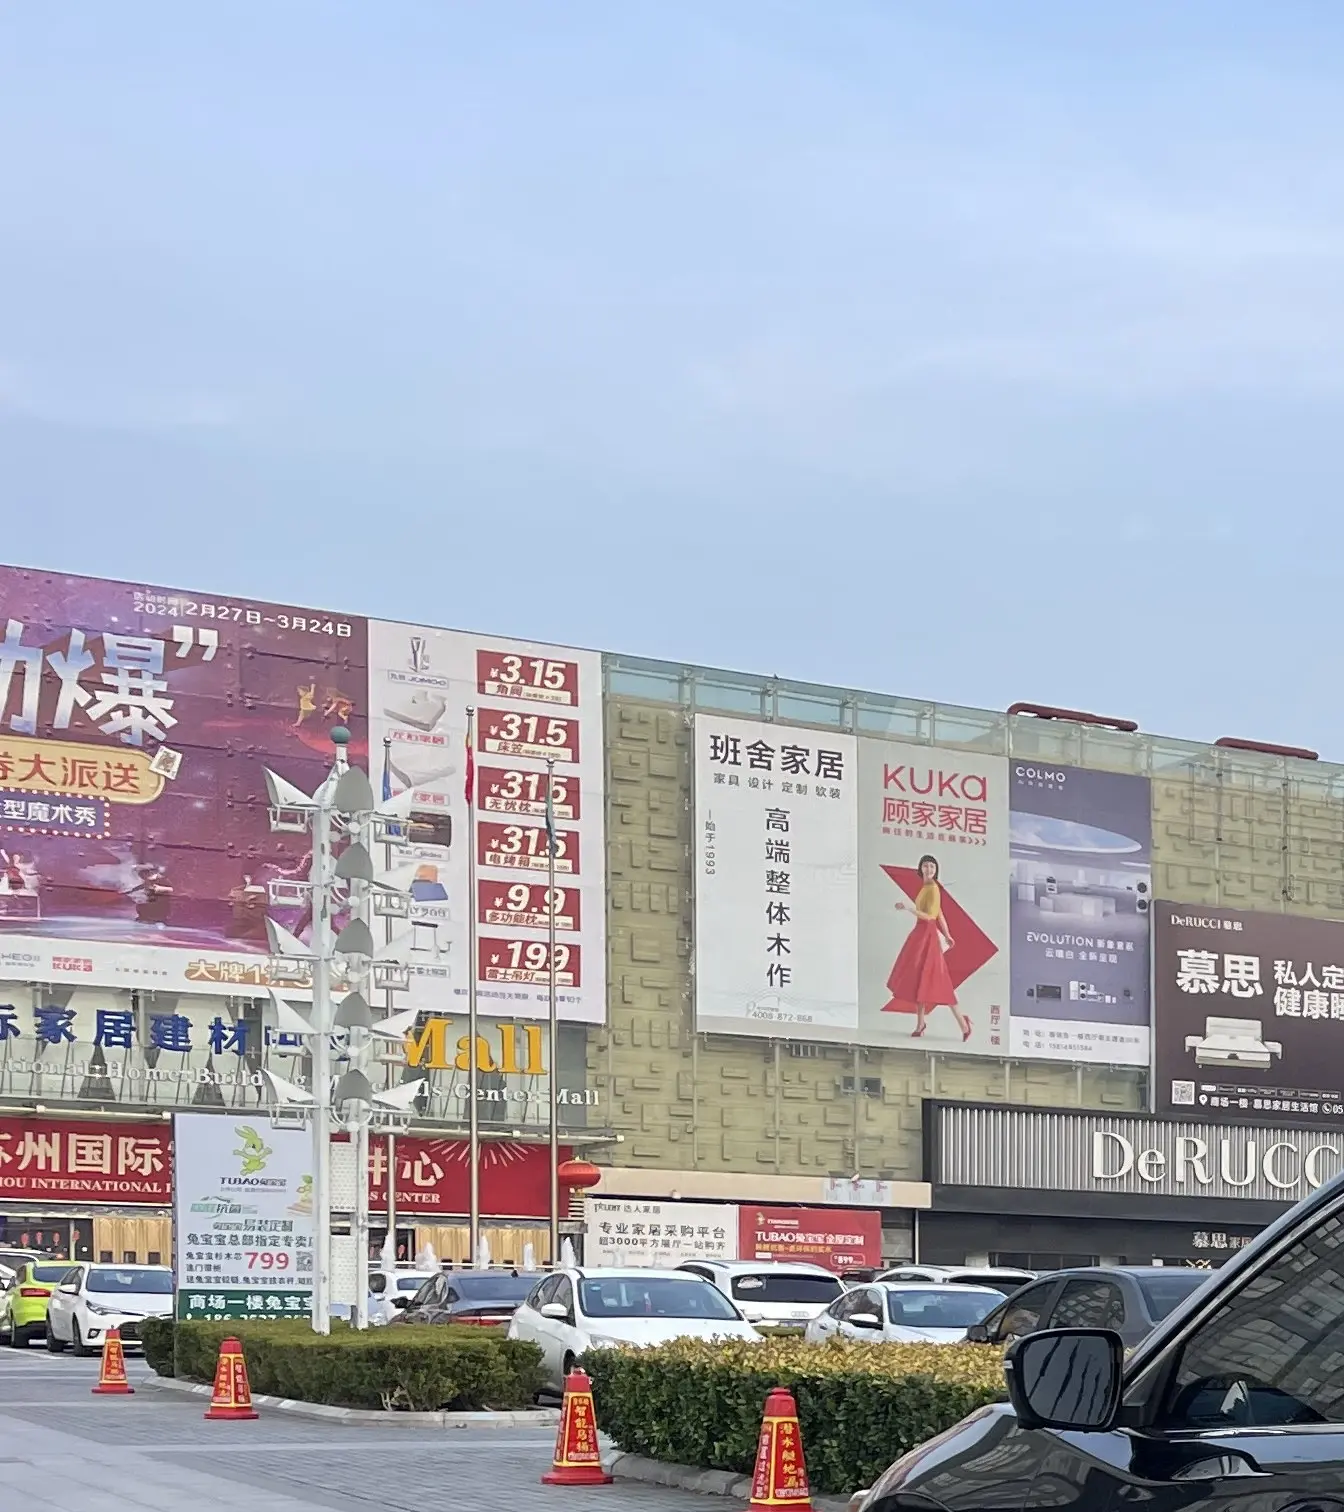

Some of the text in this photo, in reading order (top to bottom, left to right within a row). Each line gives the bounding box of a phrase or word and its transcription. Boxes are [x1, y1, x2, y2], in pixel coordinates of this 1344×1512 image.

[133, 601, 179, 617] 2024
[709, 734, 845, 781] 班舍家居
[713, 772, 842, 800] 家具 设计 定制 软装
[1015, 766, 1066, 783] COLMO
[0, 799, 97, 827] 型魔术秀
[882, 797, 988, 835] 顾家家居
[765, 807, 792, 988] 高端整体木作
[1170, 914, 1222, 930] DeRUCCI
[1026, 931, 1095, 948] EVOLUTION
[1175, 949, 1264, 998] 慕思
[403, 1017, 549, 1075] Mall
[106, 1061, 186, 1084] Home
[31, 1177, 162, 1194] INTERNATIONAL
[599, 1222, 726, 1239] 专业家居采购平台
[244, 1251, 290, 1270] 799
